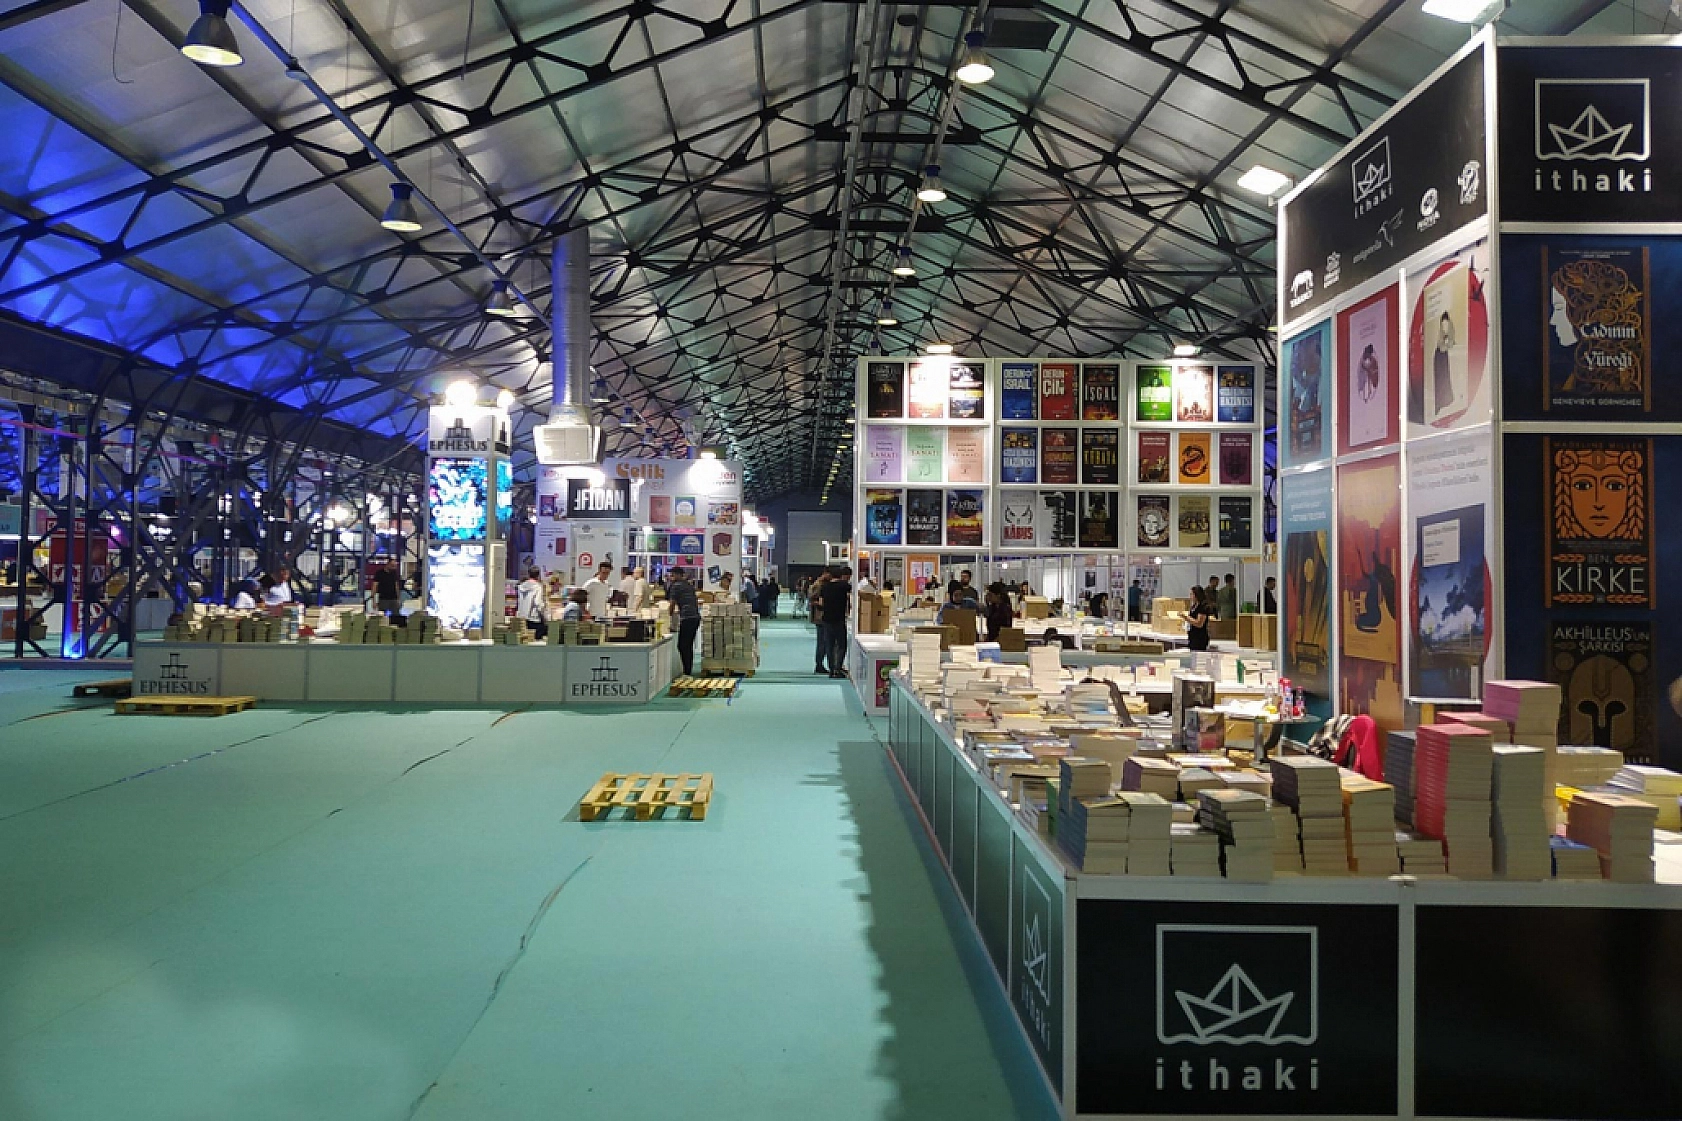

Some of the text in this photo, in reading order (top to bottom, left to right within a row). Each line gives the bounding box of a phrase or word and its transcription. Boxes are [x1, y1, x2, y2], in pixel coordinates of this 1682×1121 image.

[1534, 168, 1653, 192] ithaki
[1354, 182, 1393, 220] ithaki
[429, 440, 488, 452] EPHESUS
[1557, 563, 1645, 593] KİRKE
[139, 680, 208, 694] EPHESUS
[571, 682, 638, 697] EPHESUS
[1155, 1056, 1320, 1091] ithaki
